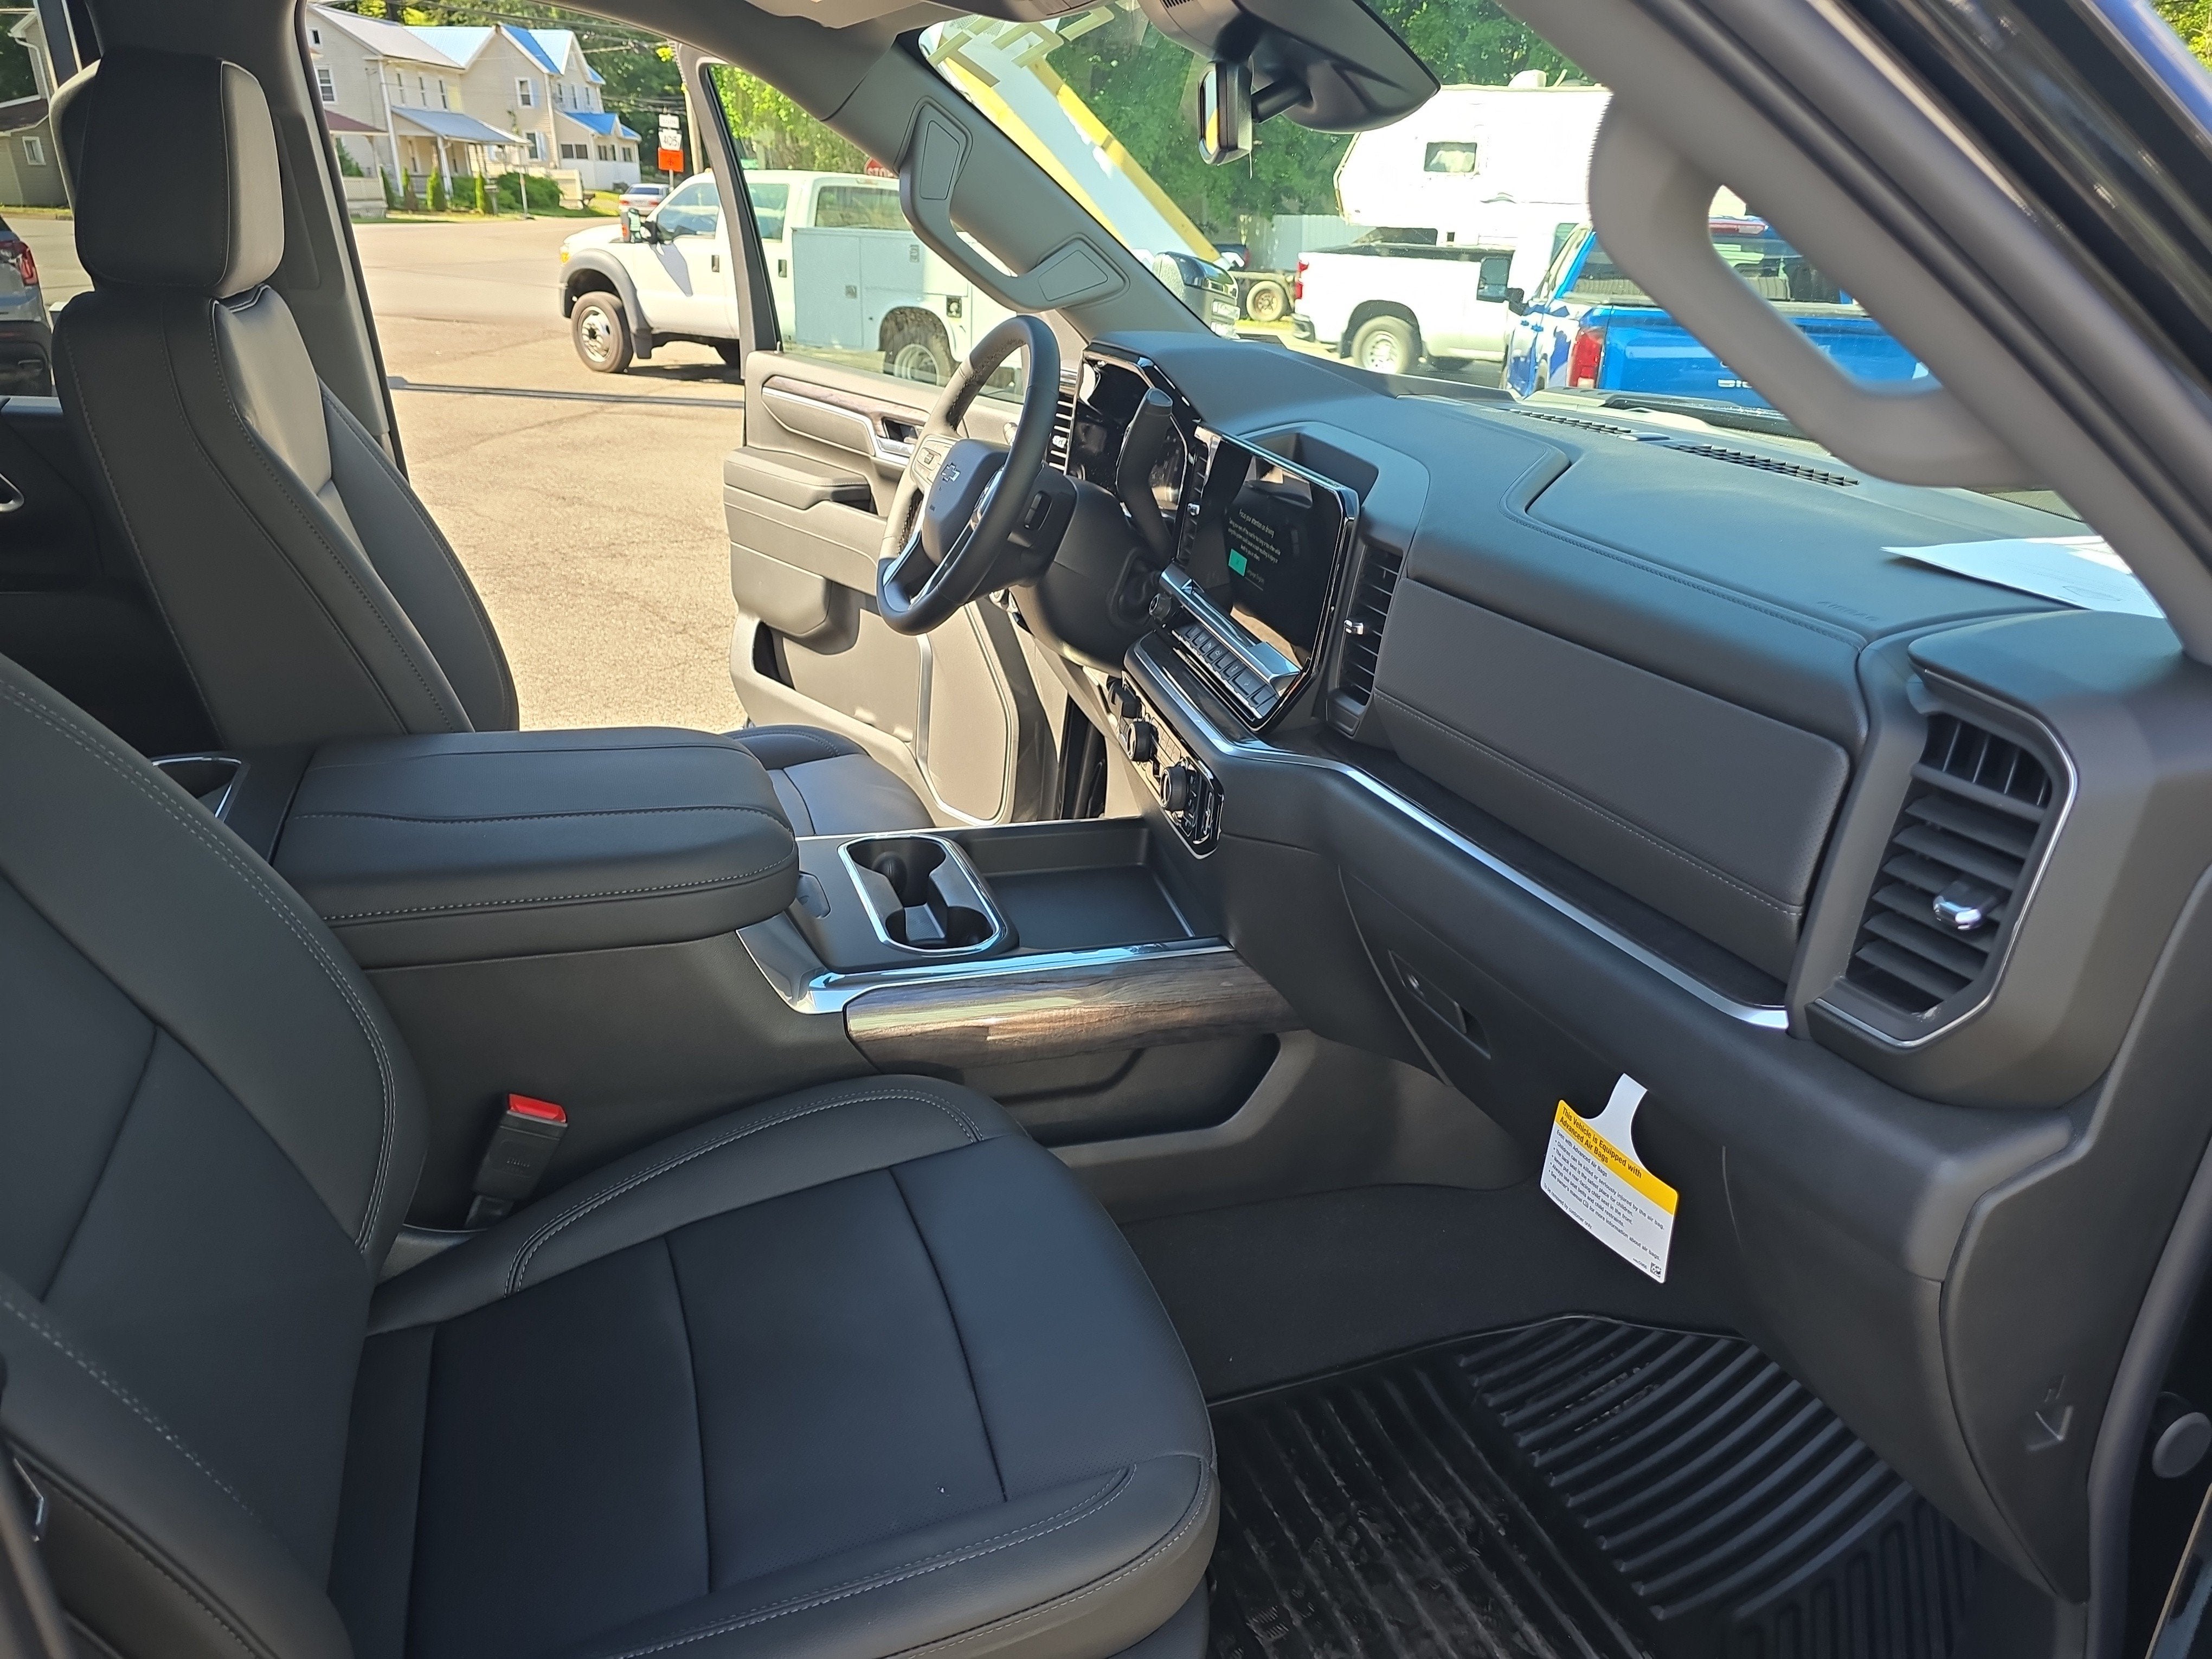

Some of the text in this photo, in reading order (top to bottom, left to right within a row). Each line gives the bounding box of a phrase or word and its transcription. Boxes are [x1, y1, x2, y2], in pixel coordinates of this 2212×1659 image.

[1560, 1116, 1608, 1163] Advanced Air Bags
[1562, 1106, 1641, 1178] This Vehicle is Equipped with
